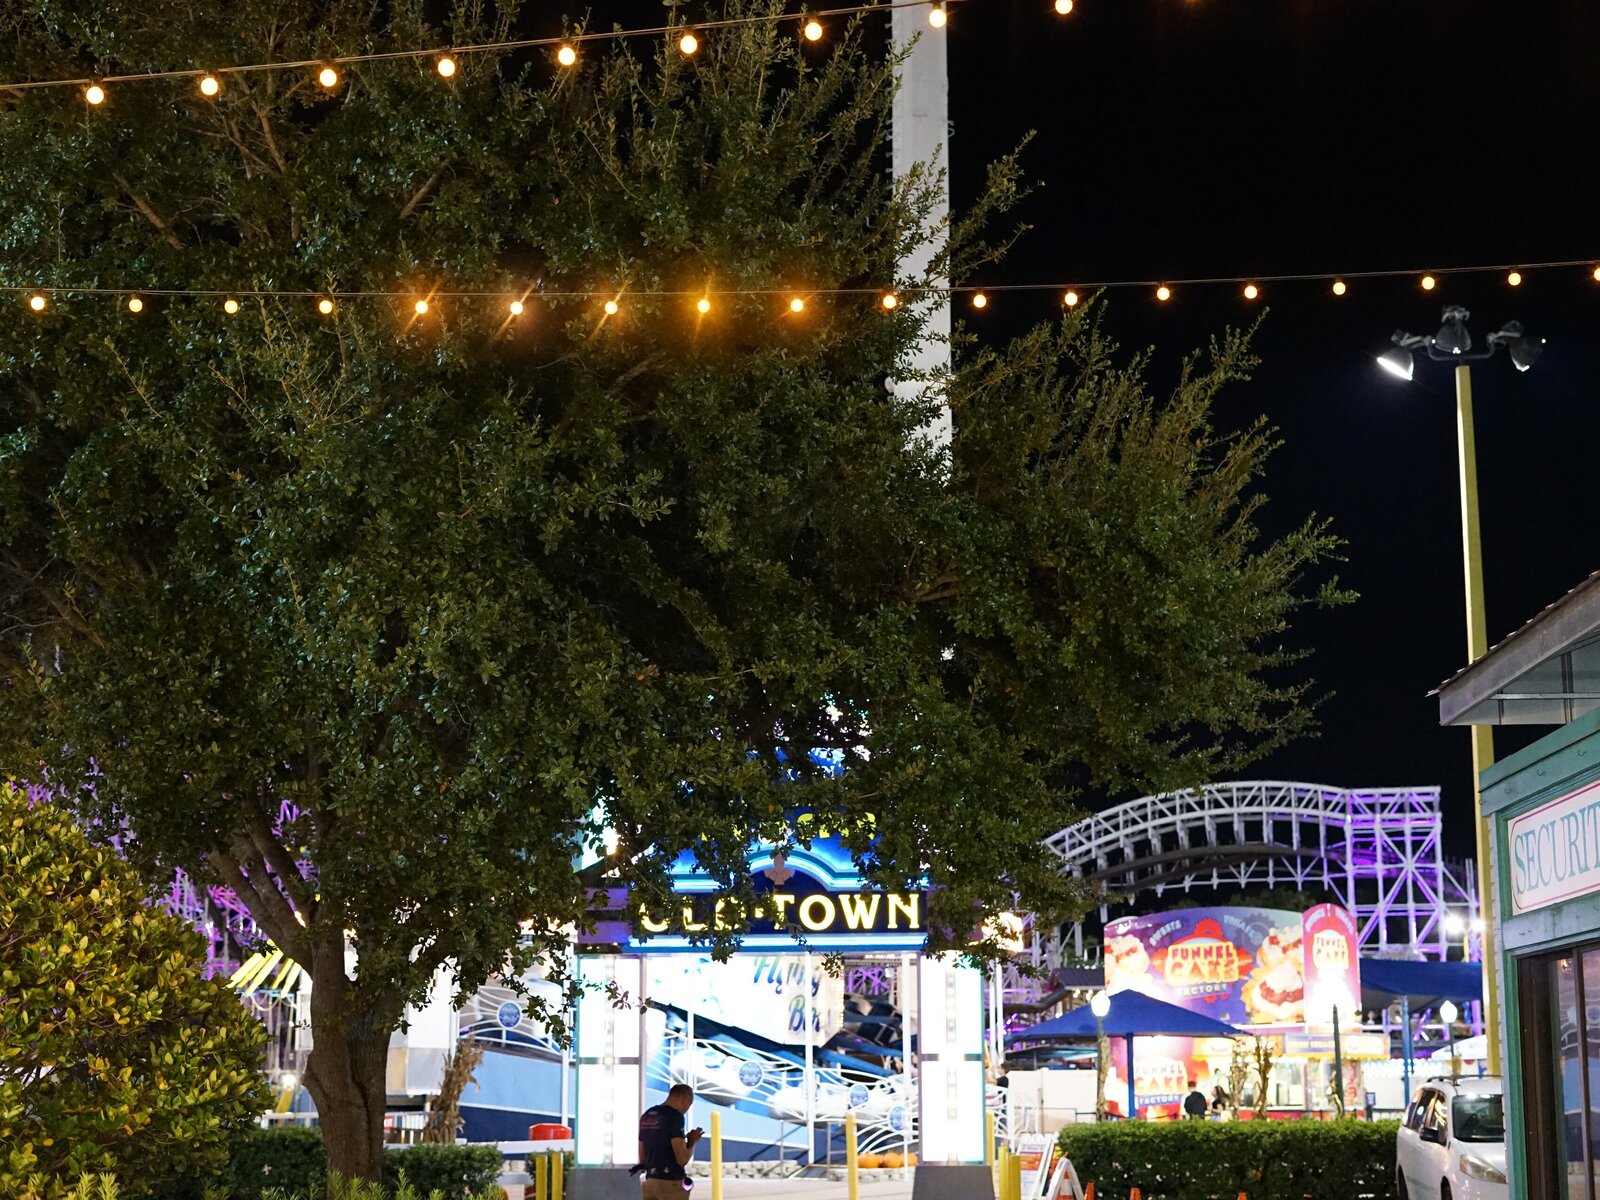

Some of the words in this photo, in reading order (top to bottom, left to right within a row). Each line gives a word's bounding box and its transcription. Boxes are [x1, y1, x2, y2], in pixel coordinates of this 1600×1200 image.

[771, 893, 920, 931] TOWN
[1171, 944, 1234, 960] FUNNEL
[1170, 959, 1235, 982] CAKE
[1134, 1075, 1185, 1092] CAKE
